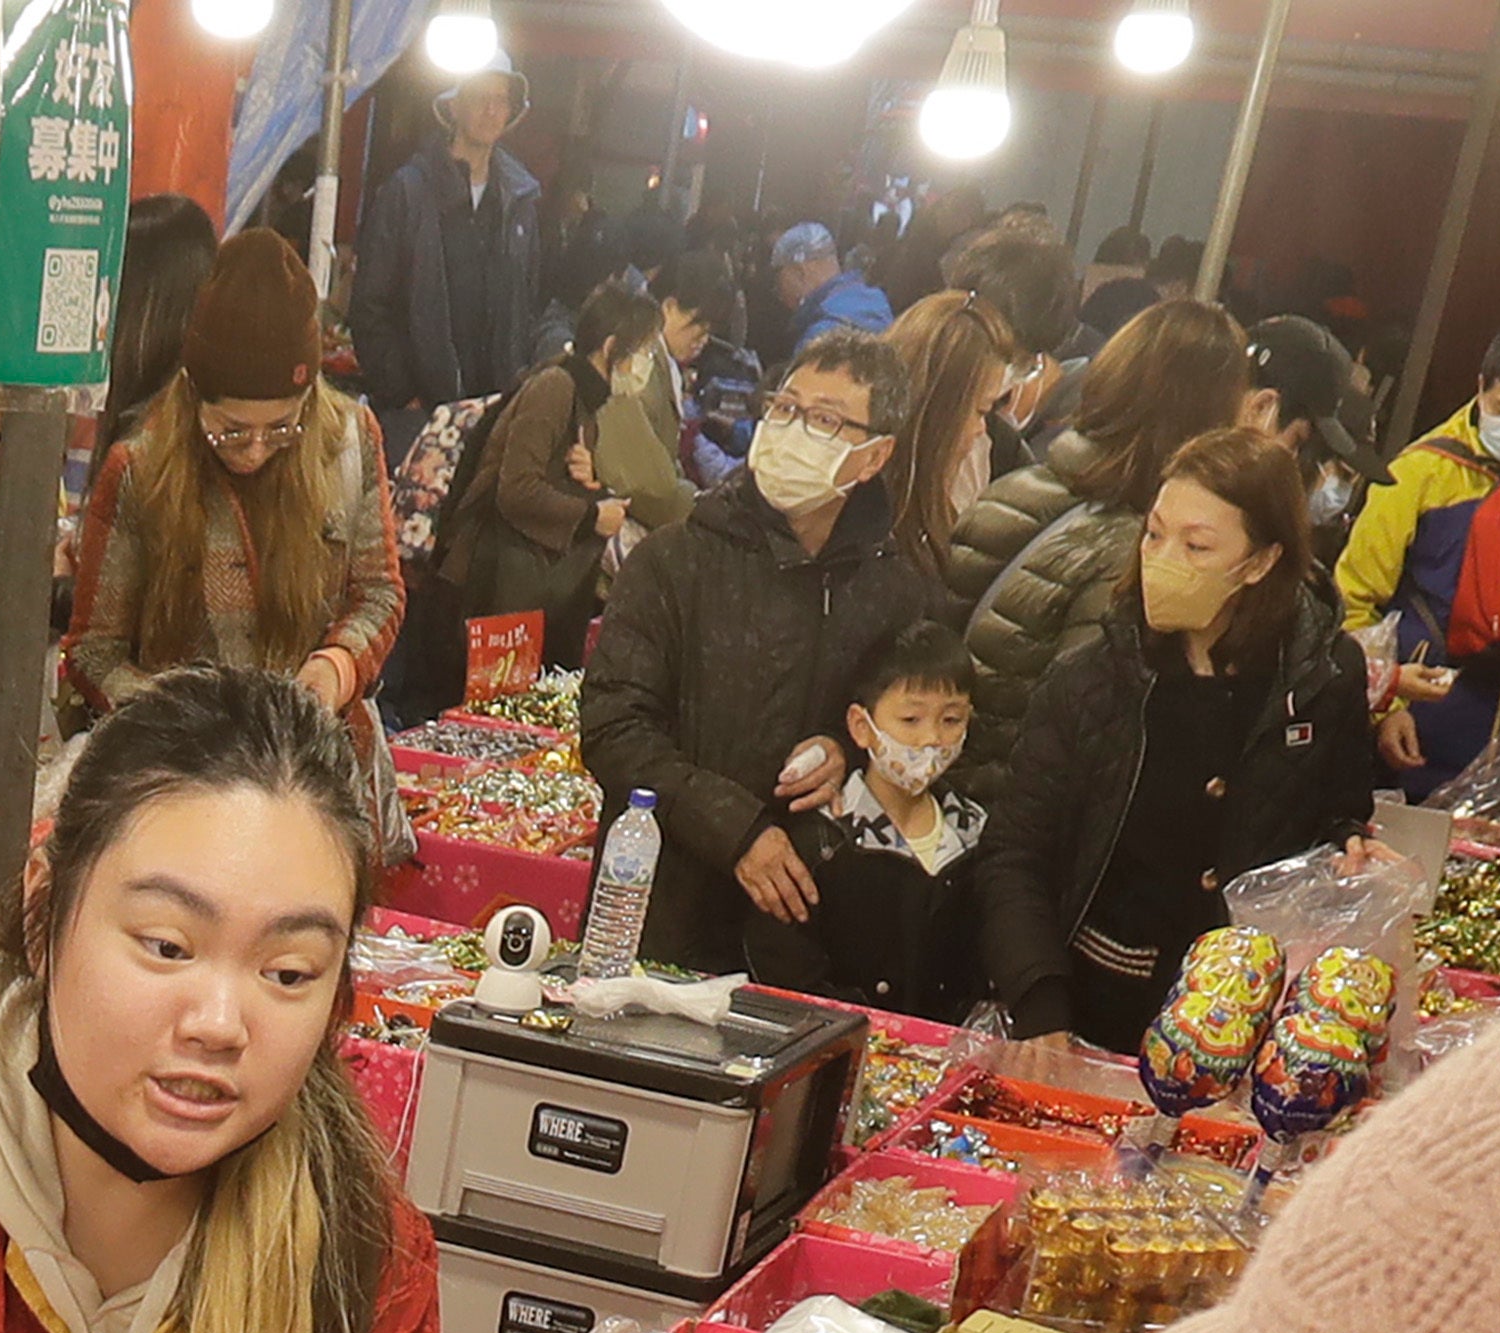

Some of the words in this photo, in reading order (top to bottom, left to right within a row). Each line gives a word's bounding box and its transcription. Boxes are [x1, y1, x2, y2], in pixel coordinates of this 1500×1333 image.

[52, 38, 115, 108] 好友
[27, 116, 121, 186] 募集中
[539, 1110, 585, 1142] WHERE
[508, 1299, 552, 1330] WHERE
